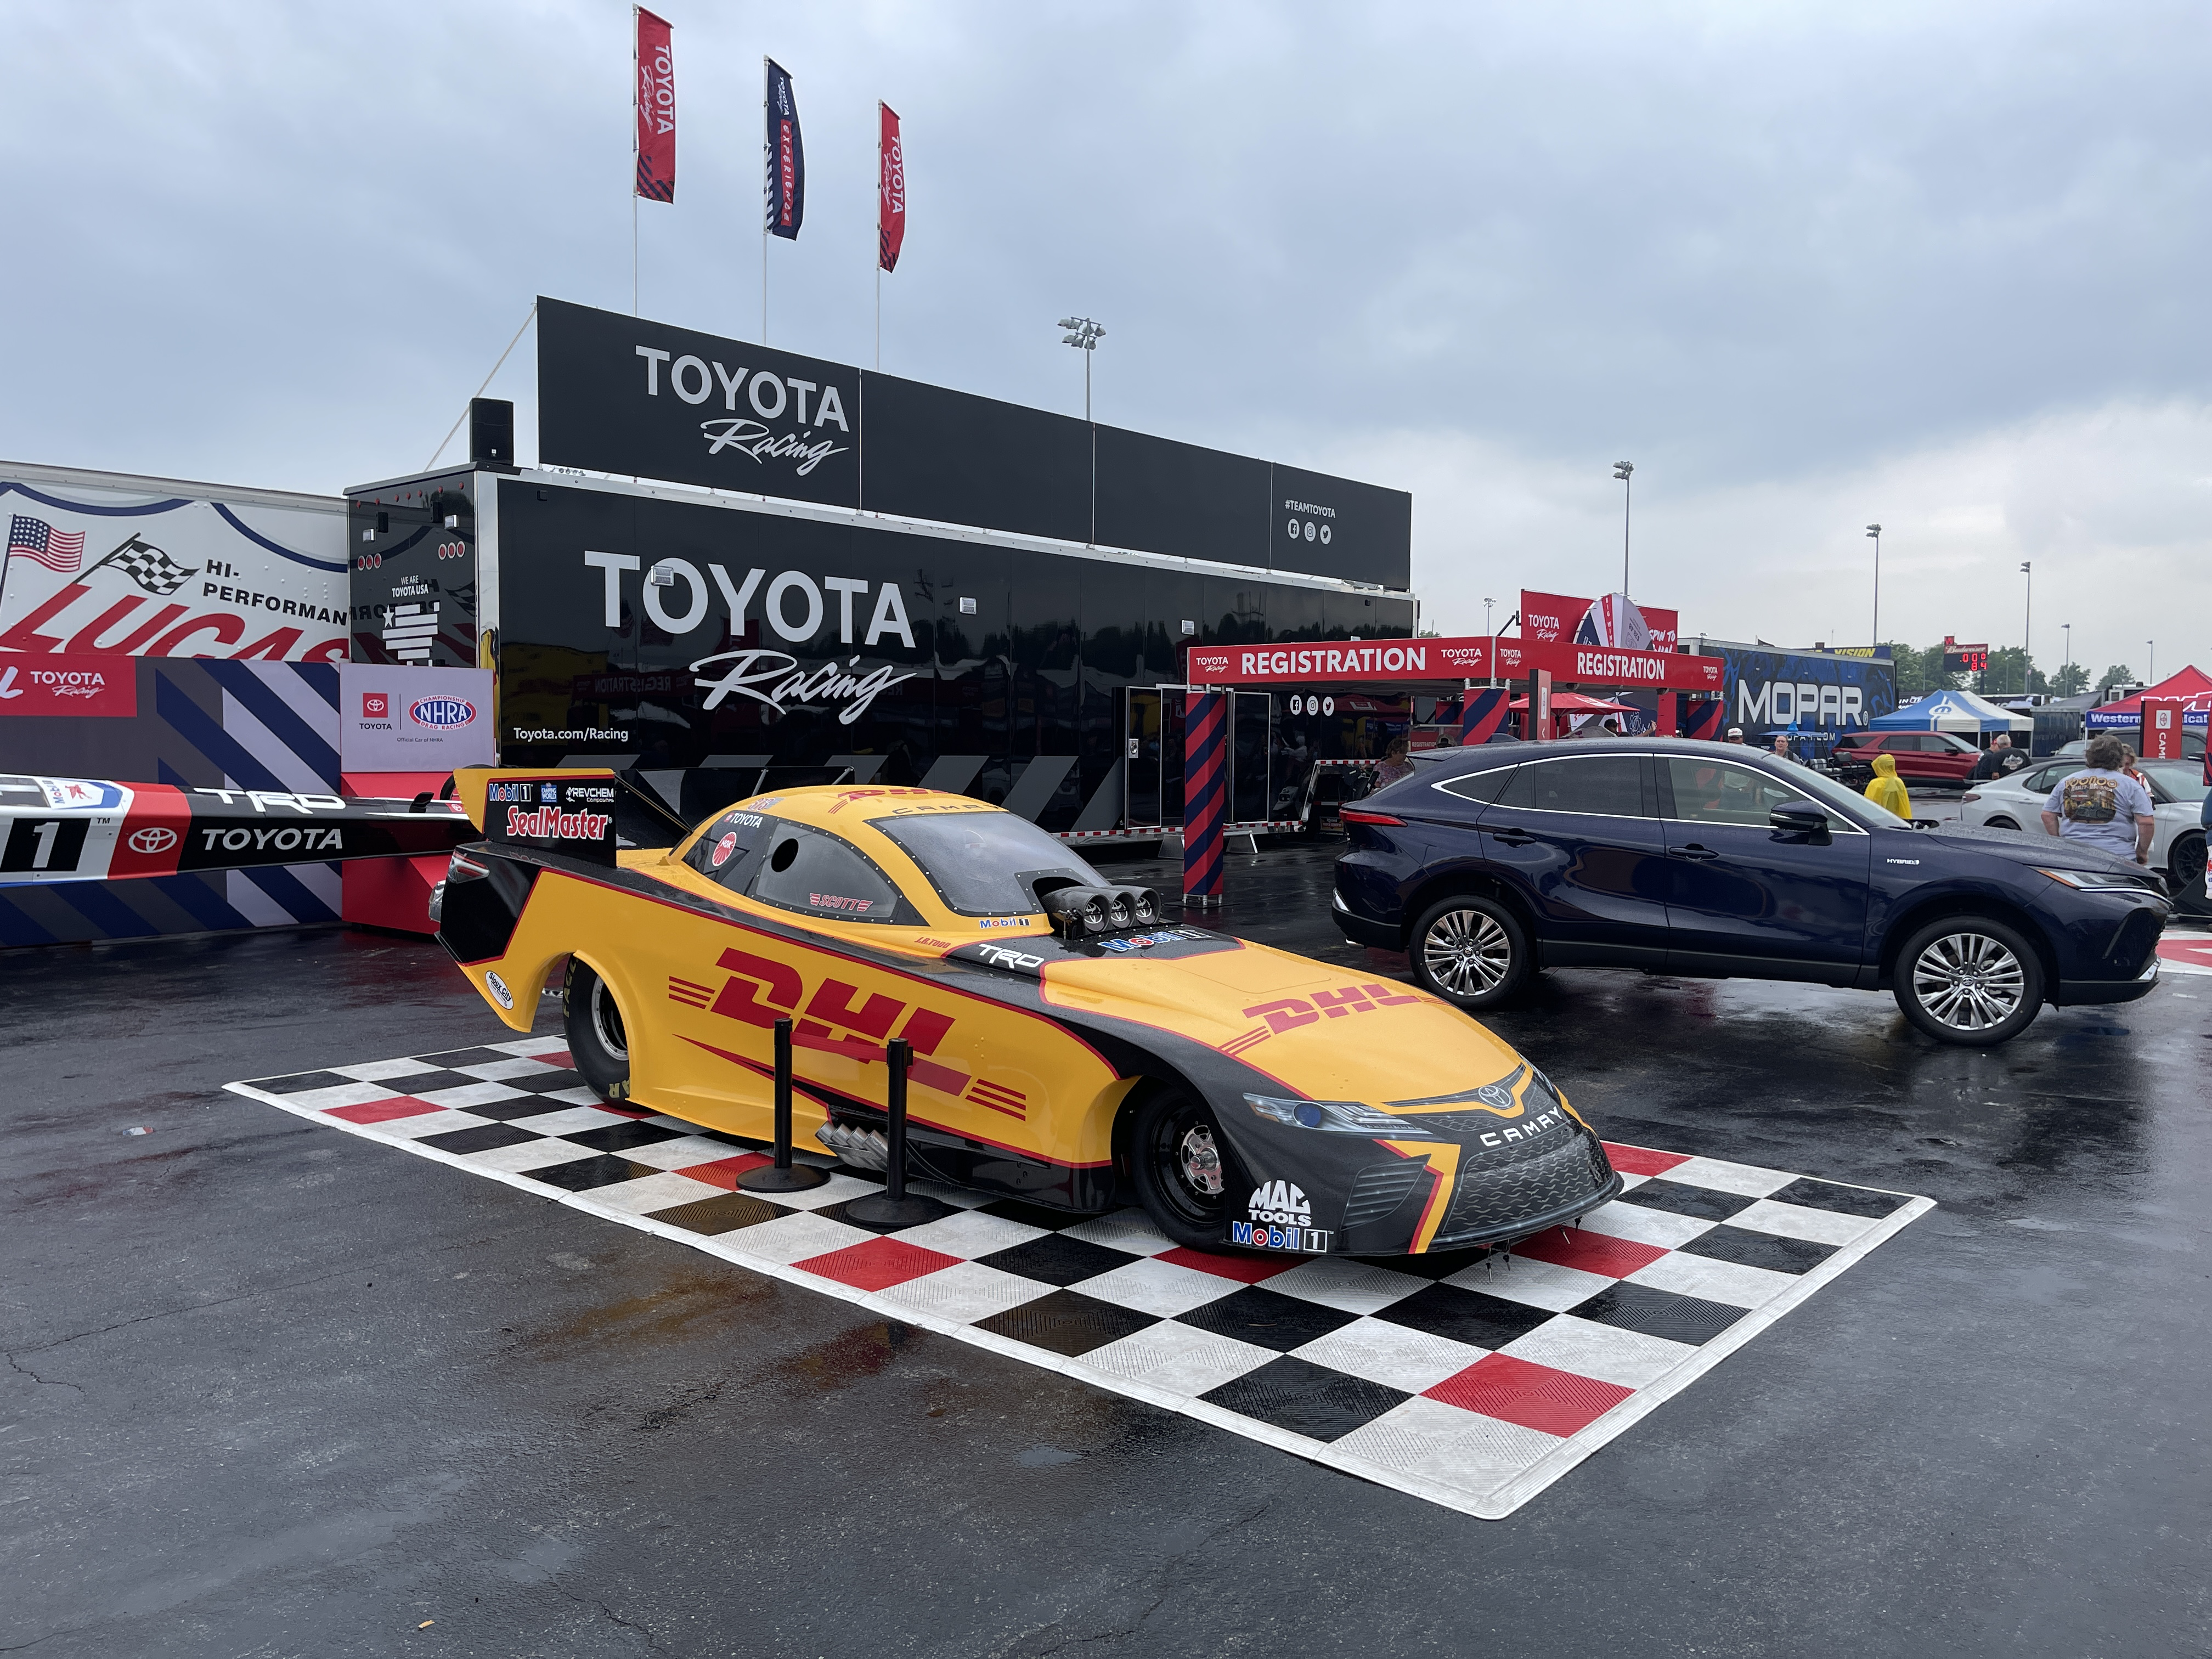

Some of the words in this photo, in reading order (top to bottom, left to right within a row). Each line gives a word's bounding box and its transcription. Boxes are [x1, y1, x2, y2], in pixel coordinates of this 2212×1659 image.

[655, 45, 674, 134] TOYOTA
[780, 76, 789, 116] TOYOTA
[783, 124, 793, 222] EXPERIENCE
[891, 136, 904, 214] TOYOTA
[635, 345, 849, 432] TOYOTA
[700, 419, 849, 476] Racing
[1285, 499, 1336, 519] #TEAMTOYOTA
[206, 559, 240, 578] HI-
[400, 576, 409, 585] WE
[409, 575, 419, 584] ARE
[392, 585, 415, 598] TOYOTA
[416, 584, 428, 595] USA
[584, 551, 916, 648] TOYOTA
[203, 583, 348, 627] PERFORMAN
[1528, 614, 1560, 629] TOYOTA
[1649, 629, 1666, 641] SPIN
[1667, 630, 1675, 642] TO
[1441, 648, 1482, 658] TOYOTA
[1500, 648, 1521, 658] TOYOTA
[1946, 645, 1987, 653] Budweiser
[1196, 656, 1228, 665] TOYOTA
[1242, 647, 1425, 675] REGISTRATION
[1452, 658, 1482, 667] Racing
[1577, 652, 1664, 680] REGISTRATION
[1703, 665, 1718, 674] TOYOTA
[31, 671, 105, 685] TOYOTA
[689, 650, 917, 725] Racing
[53, 685, 104, 699] Racing
[1738, 679, 1862, 726] MOPAR
[420, 702, 467, 724] NHRA
[2091, 714, 2141, 723] Western
[421, 721, 438, 730] DRAG
[514, 727, 629, 743] Toyota.com/Racing
[194, 788, 346, 815] TRD
[489, 783, 518, 802] Mobil
[573, 788, 614, 797] REVCHEM
[506, 805, 608, 840] SealMaster
[730, 812, 763, 828] TOYOTA
[32, 821, 60, 868] 1
[202, 828, 342, 850] TOYOTA
[720, 839, 733, 849] NGK
[820, 894, 860, 911] SCOTT
[979, 918, 1017, 929] Mobil
[1097, 932, 1187, 952] Mobil
[978, 943, 1045, 968] TRD
[489, 972, 502, 990] Sioux
[501, 988, 512, 1002] City
[1242, 984, 1423, 1034] DHL
[710, 947, 972, 1097] DHL
[1480, 1106, 1567, 1147] CAMRY
[1249, 1180, 1311, 1214] MAC
[1248, 1209, 1312, 1227] TOOLS
[1232, 1221, 1300, 1250] Mobil
